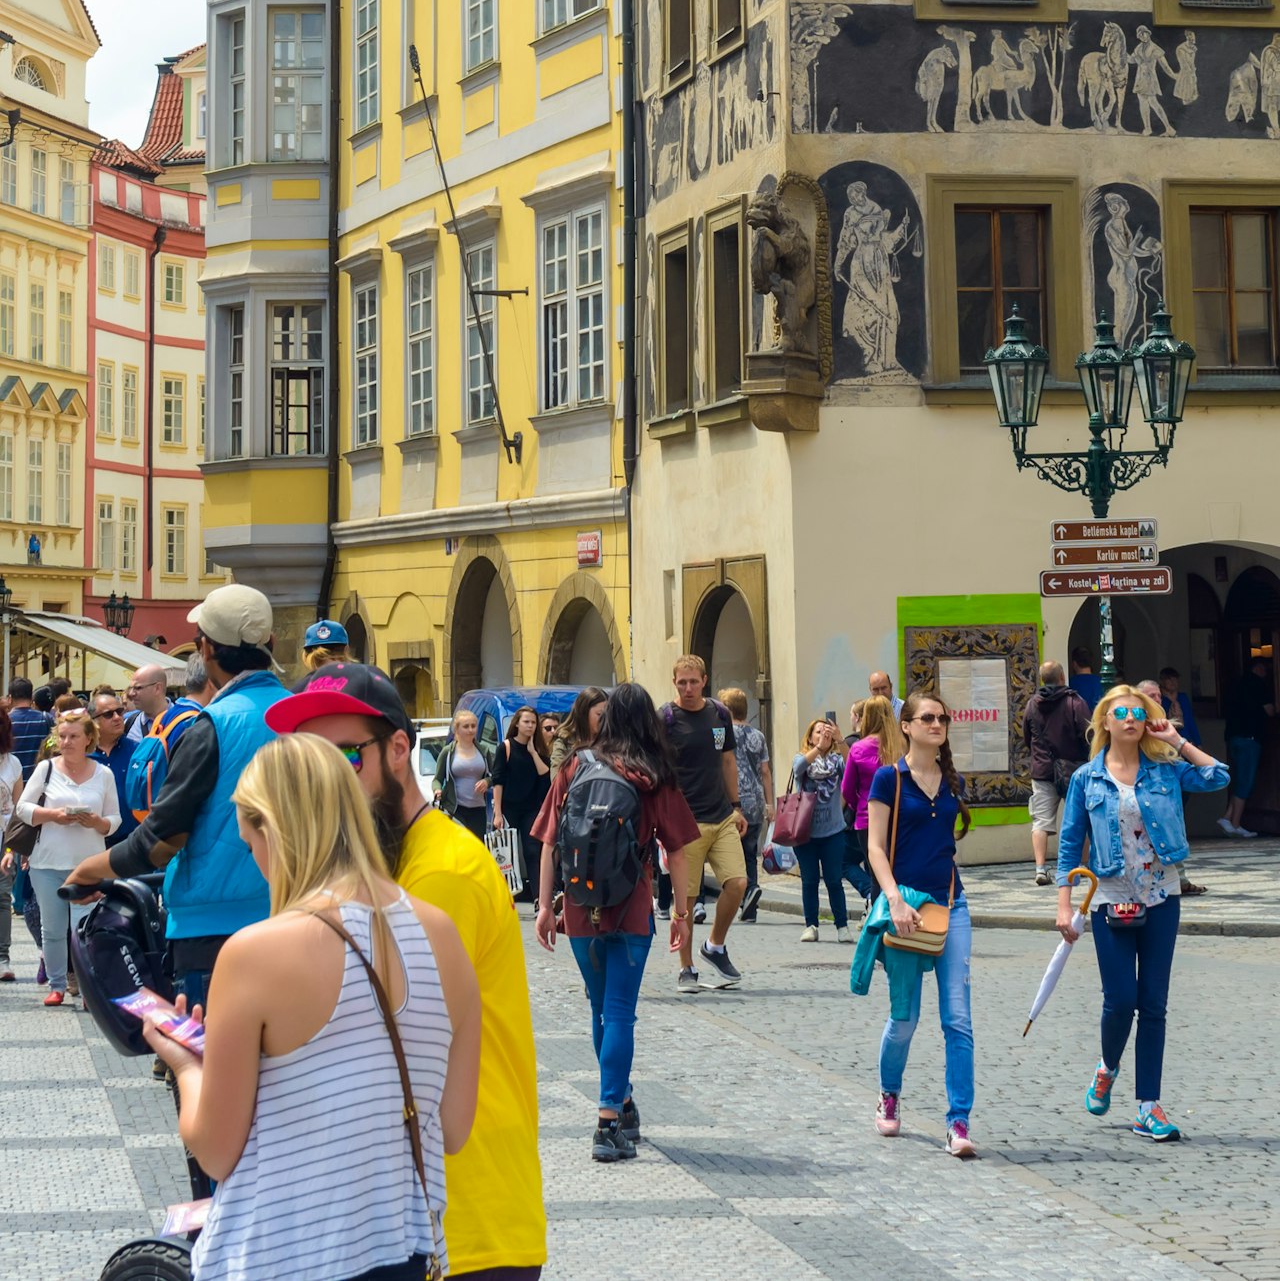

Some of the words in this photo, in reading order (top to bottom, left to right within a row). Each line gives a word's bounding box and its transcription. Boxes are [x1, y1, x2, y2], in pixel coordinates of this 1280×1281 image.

[1082, 525, 1117, 537] Betlémská
[1120, 525, 1138, 538] kaple
[1097, 549, 1118, 561] Karlův
[1121, 549, 1138, 560] most
[1068, 577, 1091, 588] Kostel
[1141, 577, 1150, 586] ve
[1153, 575, 1164, 585] zdi
